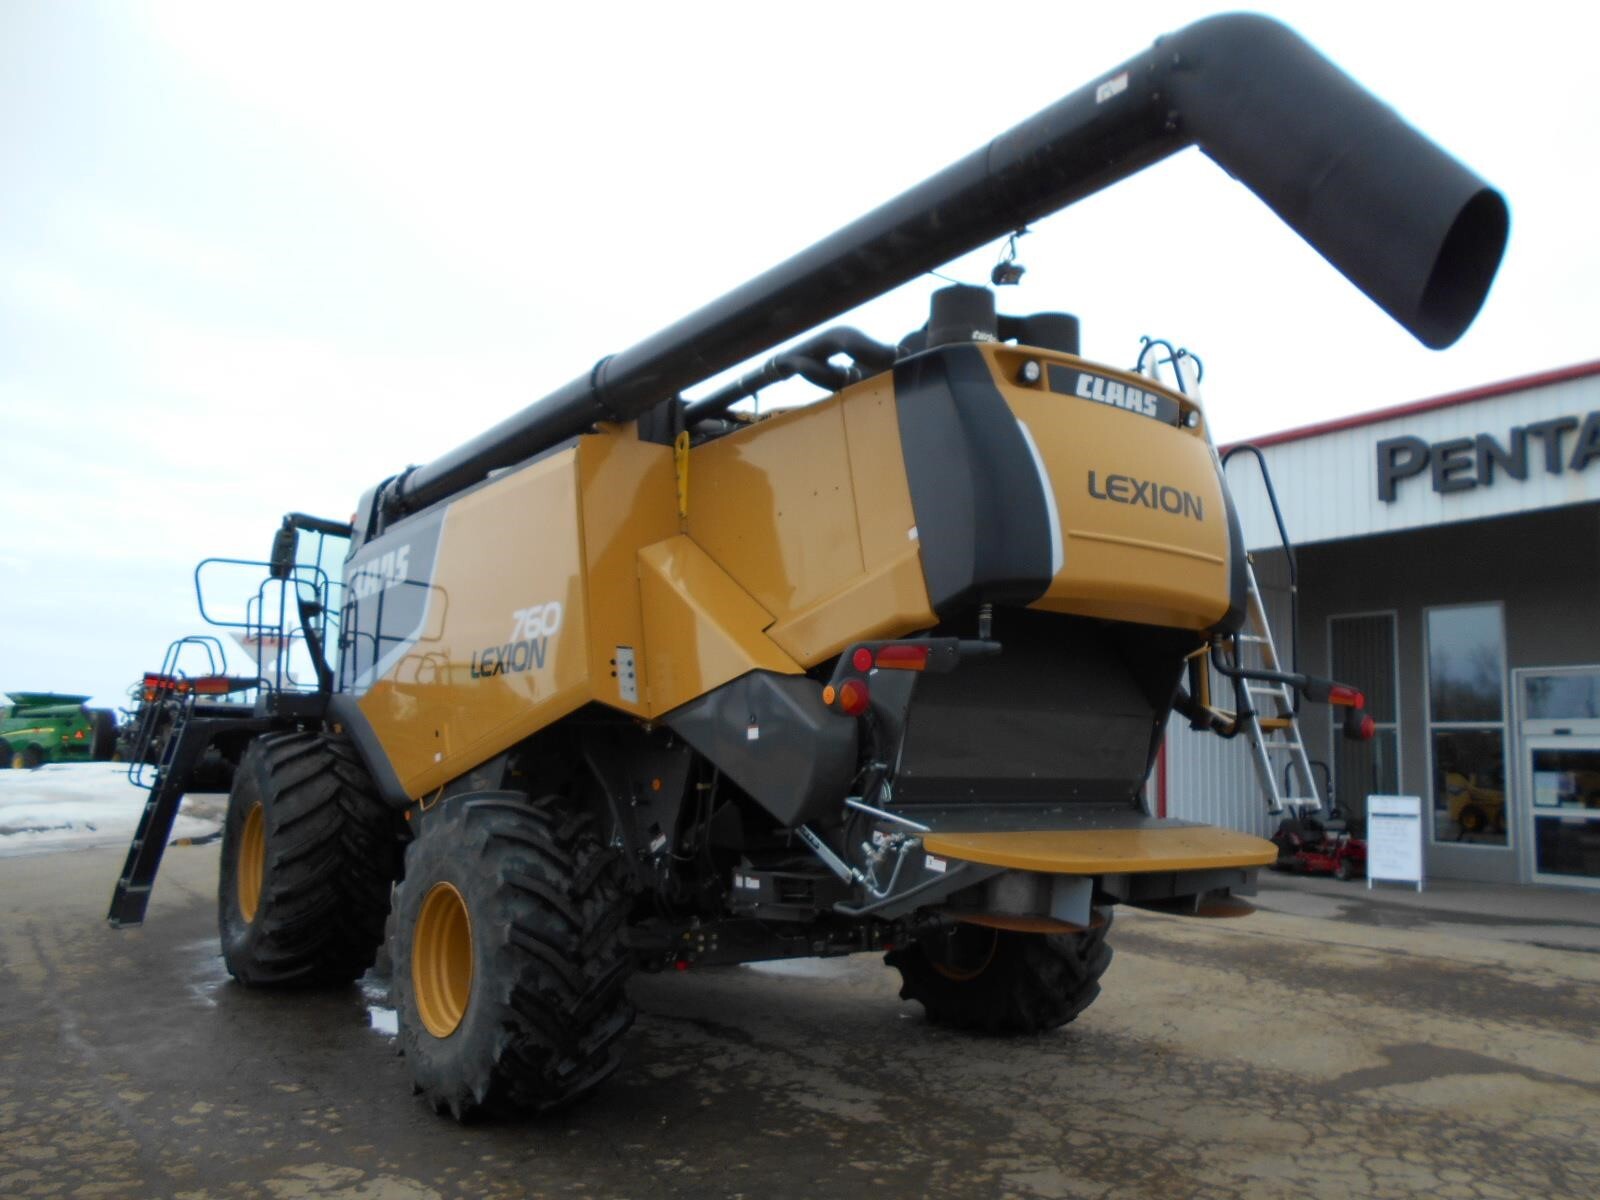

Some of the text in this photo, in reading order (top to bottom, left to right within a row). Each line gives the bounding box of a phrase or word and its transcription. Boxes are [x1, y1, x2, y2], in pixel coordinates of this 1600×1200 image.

[1076, 373, 1158, 417] CLAAS
[1087, 470, 1204, 522] LEXION
[511, 600, 562, 642] 760
[470, 636, 548, 679] LEXION
